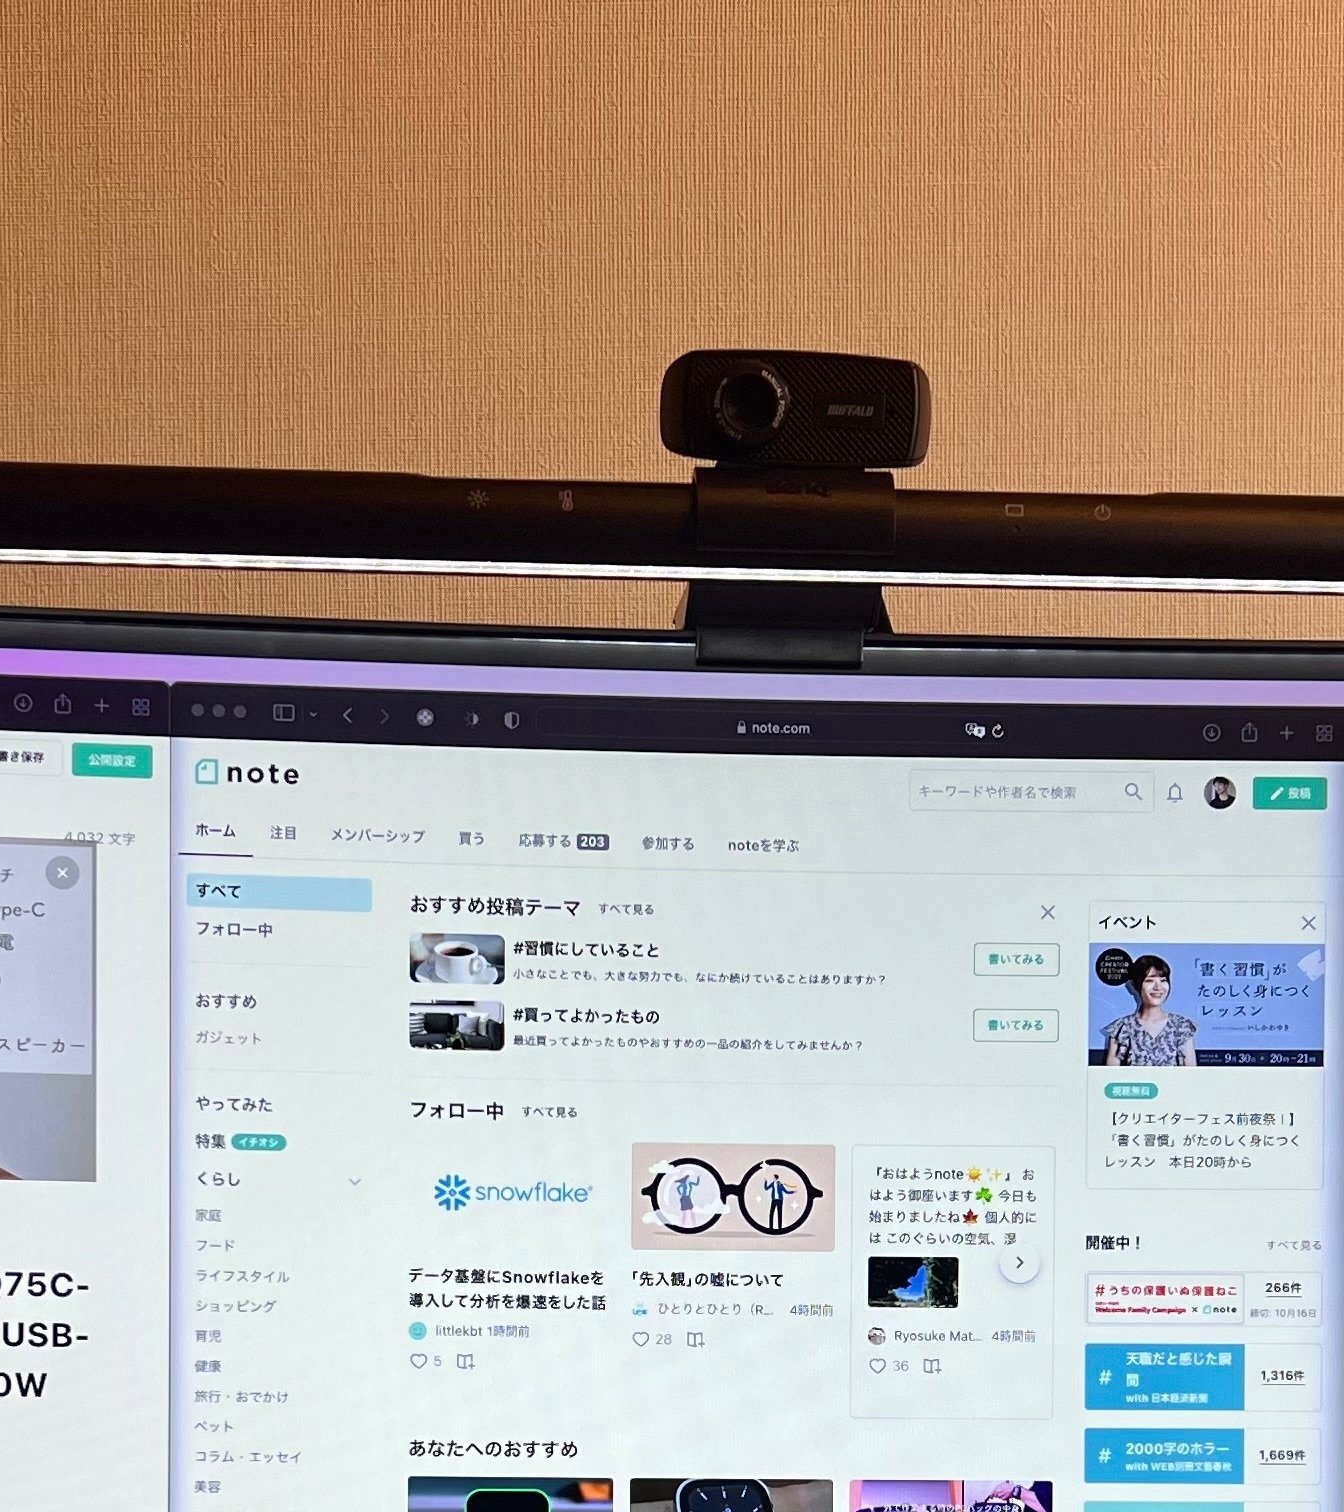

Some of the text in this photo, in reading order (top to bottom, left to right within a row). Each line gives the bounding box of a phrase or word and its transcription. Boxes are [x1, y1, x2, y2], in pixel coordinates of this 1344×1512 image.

[827, 404, 874, 417] BUFFALO
[753, 723, 810, 733] note.com
[228, 764, 299, 784] note
[196, 824, 235, 837] ホーム
[332, 829, 425, 843] メンバーシップ
[579, 837, 605, 848] 203
[729, 839, 799, 852] noteを学ぶ
[196, 883, 240, 898] すべて
[411, 896, 580, 916] おすすめ投稿テーマ
[197, 922, 272, 938] フォロー中
[1099, 916, 1155, 929] イベント
[514, 941, 658, 957] #習慣にしていること
[196, 993, 256, 1009] おすすめ
[513, 1008, 659, 1024] #買ってよかったもの
[196, 1096, 272, 1112] やってみた
[411, 1102, 503, 1120] フォロー中
[195, 1173, 241, 1187] くらし
[476, 1182, 588, 1202] snowflake
[1086, 1235, 1139, 1250] 開催中！
[409, 1268, 603, 1285] データ基盤にSnowflakeを
[1261, 1371, 1304, 1382] 1,316件
[410, 1440, 577, 1458] あなたへのおすすめ
